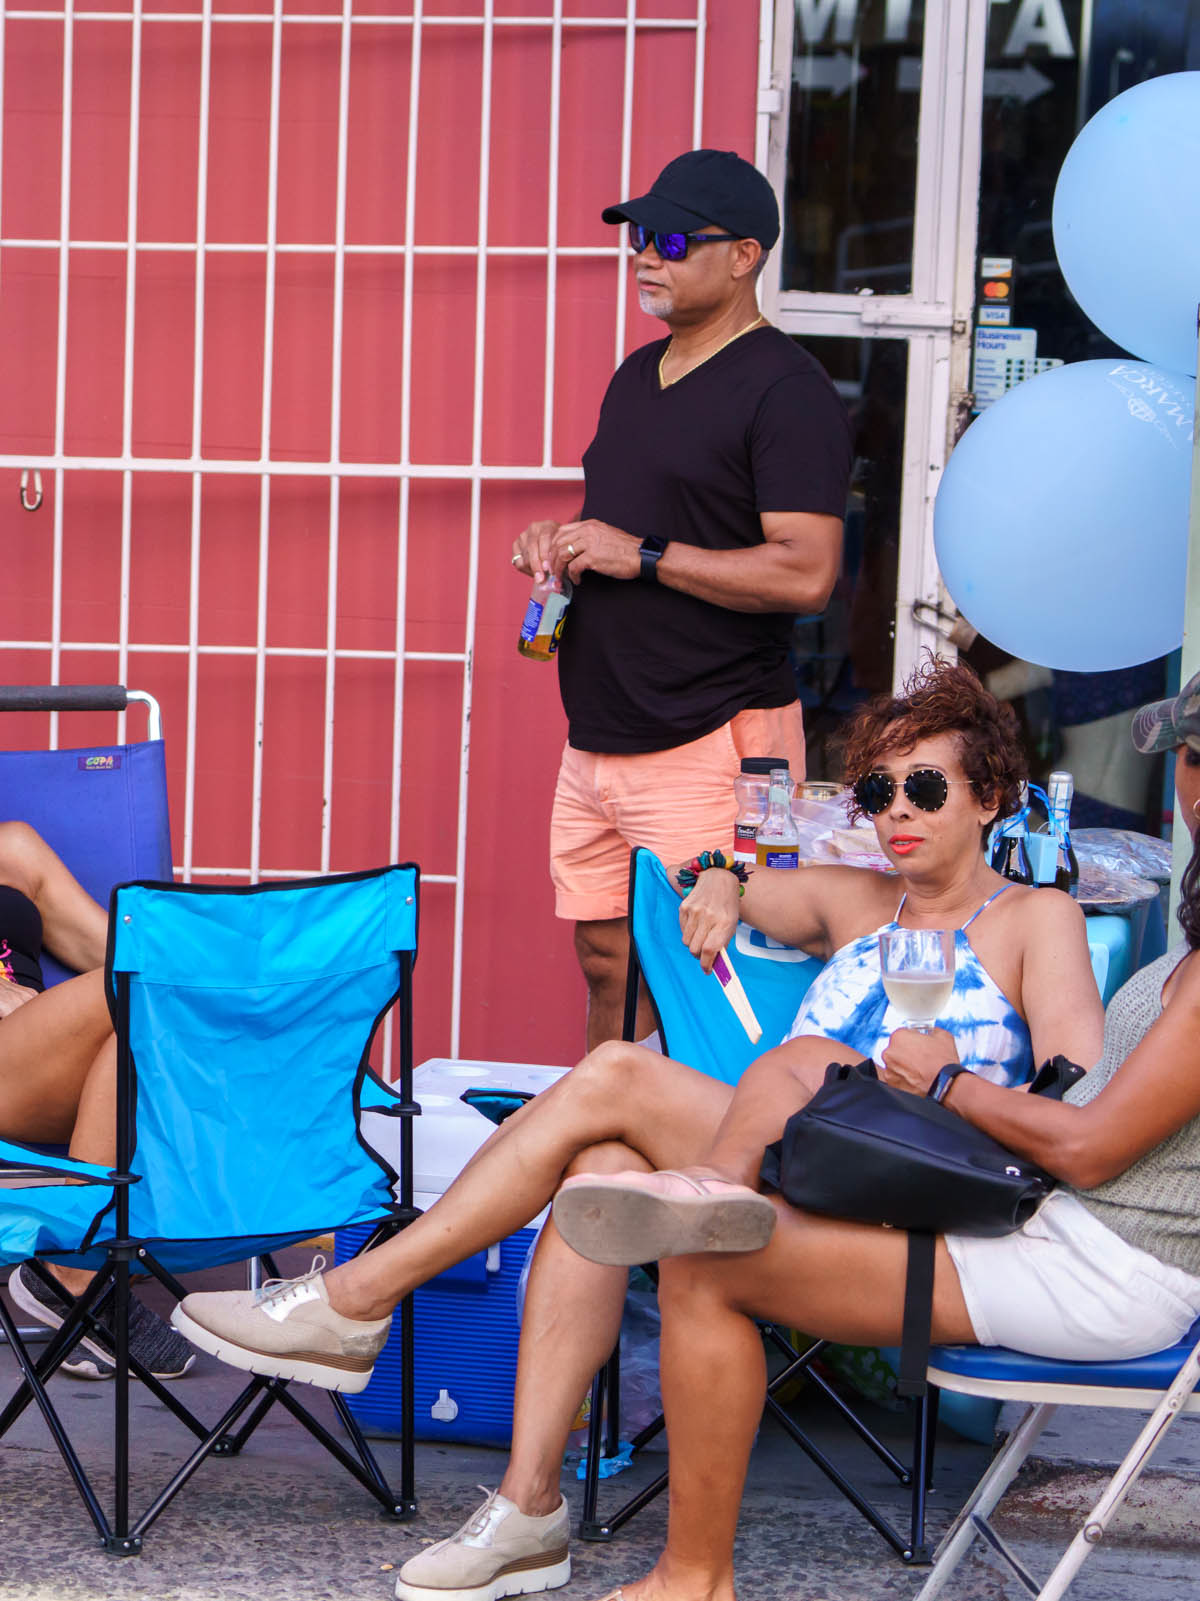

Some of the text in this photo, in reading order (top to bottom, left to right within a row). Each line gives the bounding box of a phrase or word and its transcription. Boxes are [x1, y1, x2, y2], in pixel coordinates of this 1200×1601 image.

[985, 310, 1006, 320] VISA
[976, 329, 1023, 341] Business
[976, 341, 1008, 350] Hours
